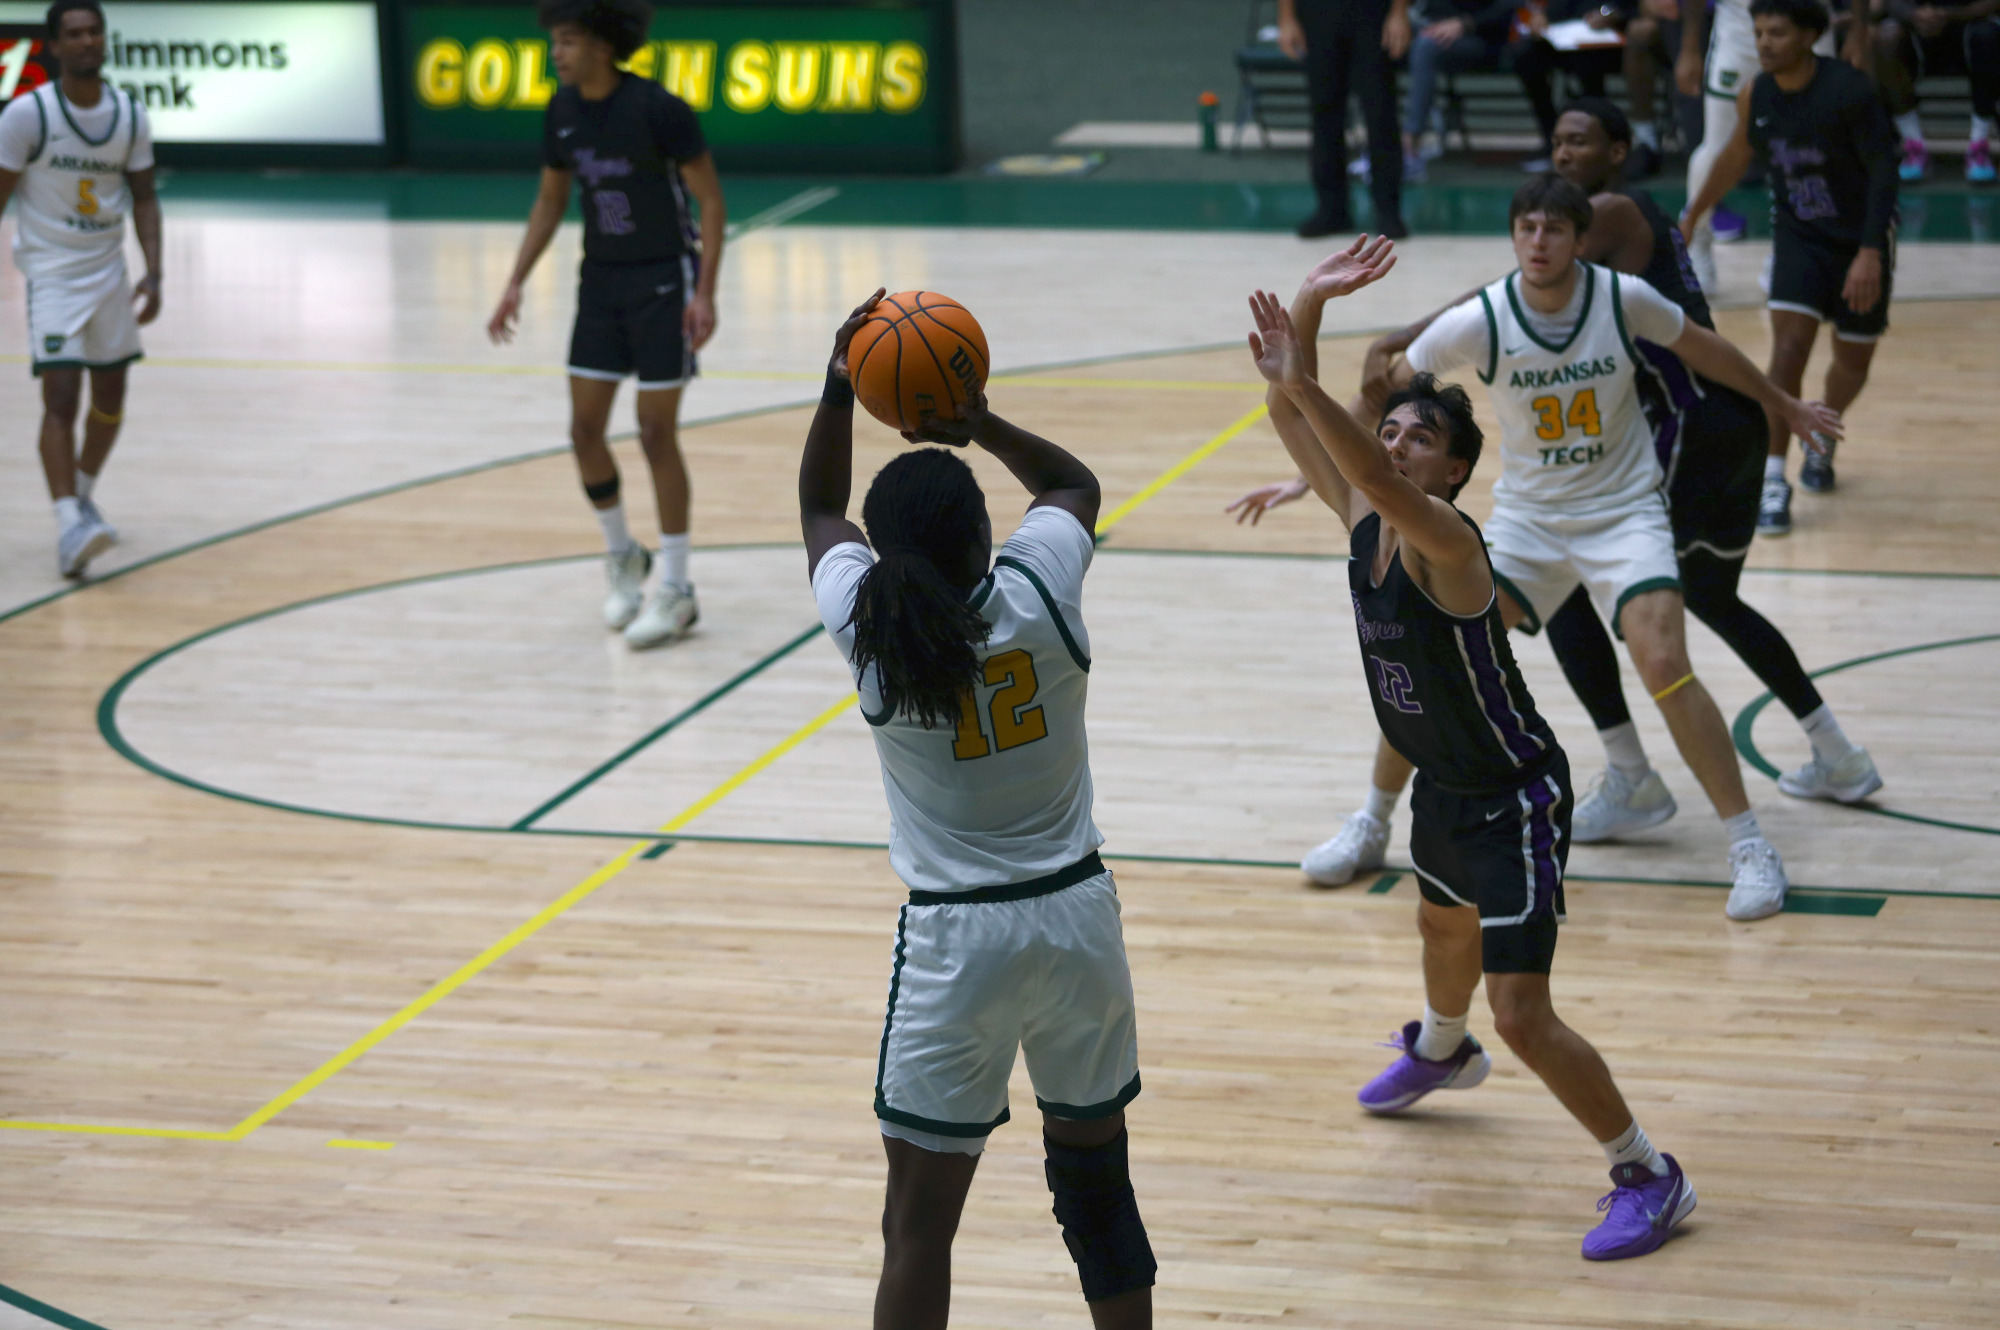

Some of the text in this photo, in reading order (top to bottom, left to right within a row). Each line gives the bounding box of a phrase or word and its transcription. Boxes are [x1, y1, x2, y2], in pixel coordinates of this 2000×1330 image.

[103, 30, 290, 71] immons
[118, 74, 196, 109] ank
[417, 38, 927, 113] GOLN SUNS
[77, 178, 100, 216] 5
[1509, 356, 1617, 388] ARKANSAS
[1531, 387, 1602, 441] 34
[1538, 442, 1604, 465] TECH
[1369, 654, 1423, 714] 12
[951, 648, 1049, 762] 12
